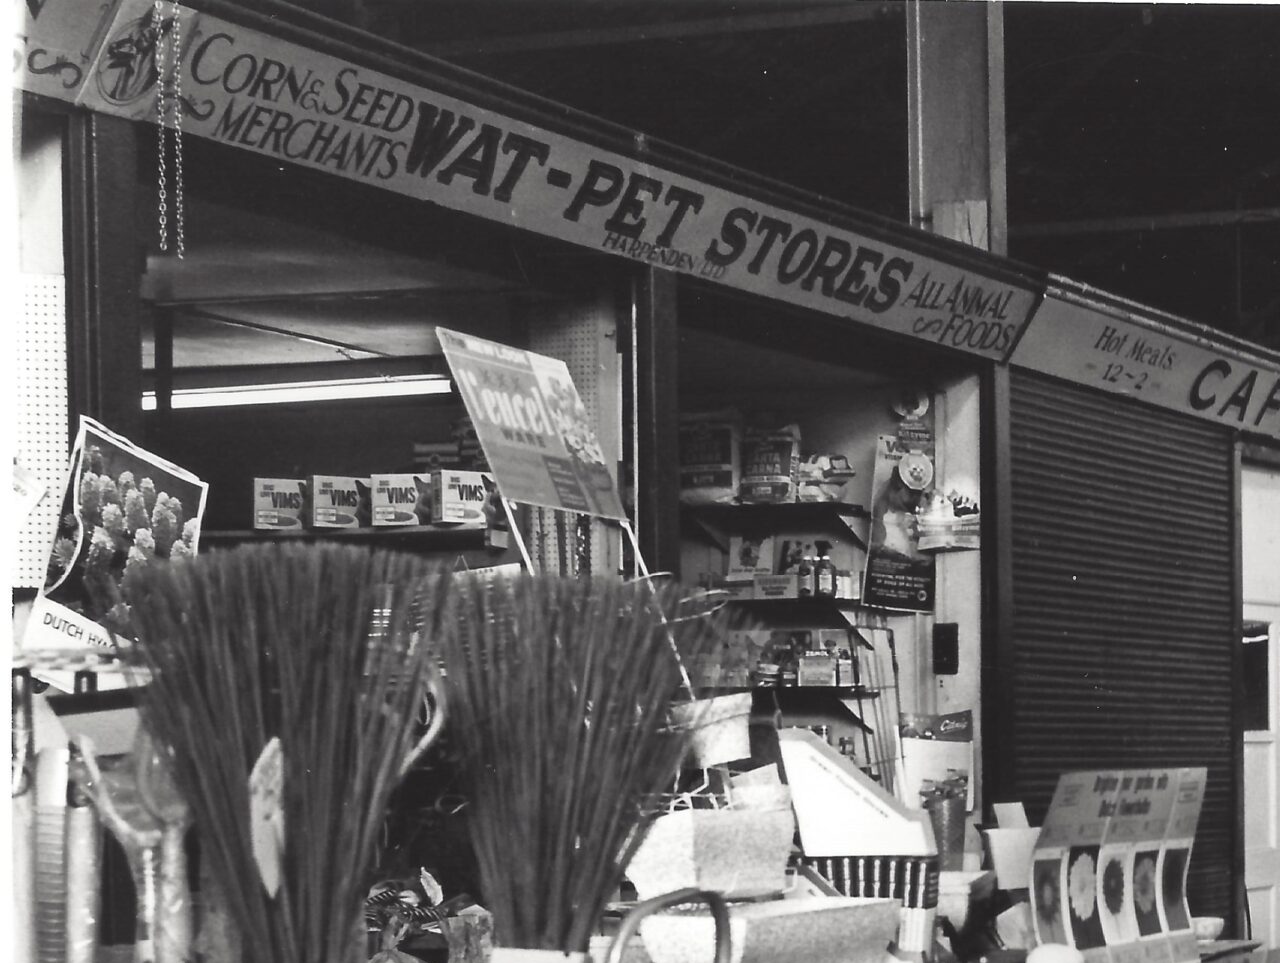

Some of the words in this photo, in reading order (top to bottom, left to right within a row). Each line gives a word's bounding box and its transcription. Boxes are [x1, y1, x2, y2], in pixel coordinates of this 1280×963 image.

[190, 33, 313, 103] CORN
[322, 68, 414, 133] SEED
[212, 102, 408, 180] MERCHANTS
[603, 231, 698, 272] HARPENDEN
[704, 207, 914, 313] STORES
[902, 271, 946, 310] ALL
[938, 275, 1014, 320] ANIMAL
[938, 314, 1016, 351] FOODS
[1094, 326, 1126, 353] Hot
[271, 492, 300, 509] VIMS
[330, 490, 358, 507] VIMS
[387, 488, 416, 504] VIMS
[458, 485, 484, 501] VIMS
[43, 612, 83, 640] DUTCH
